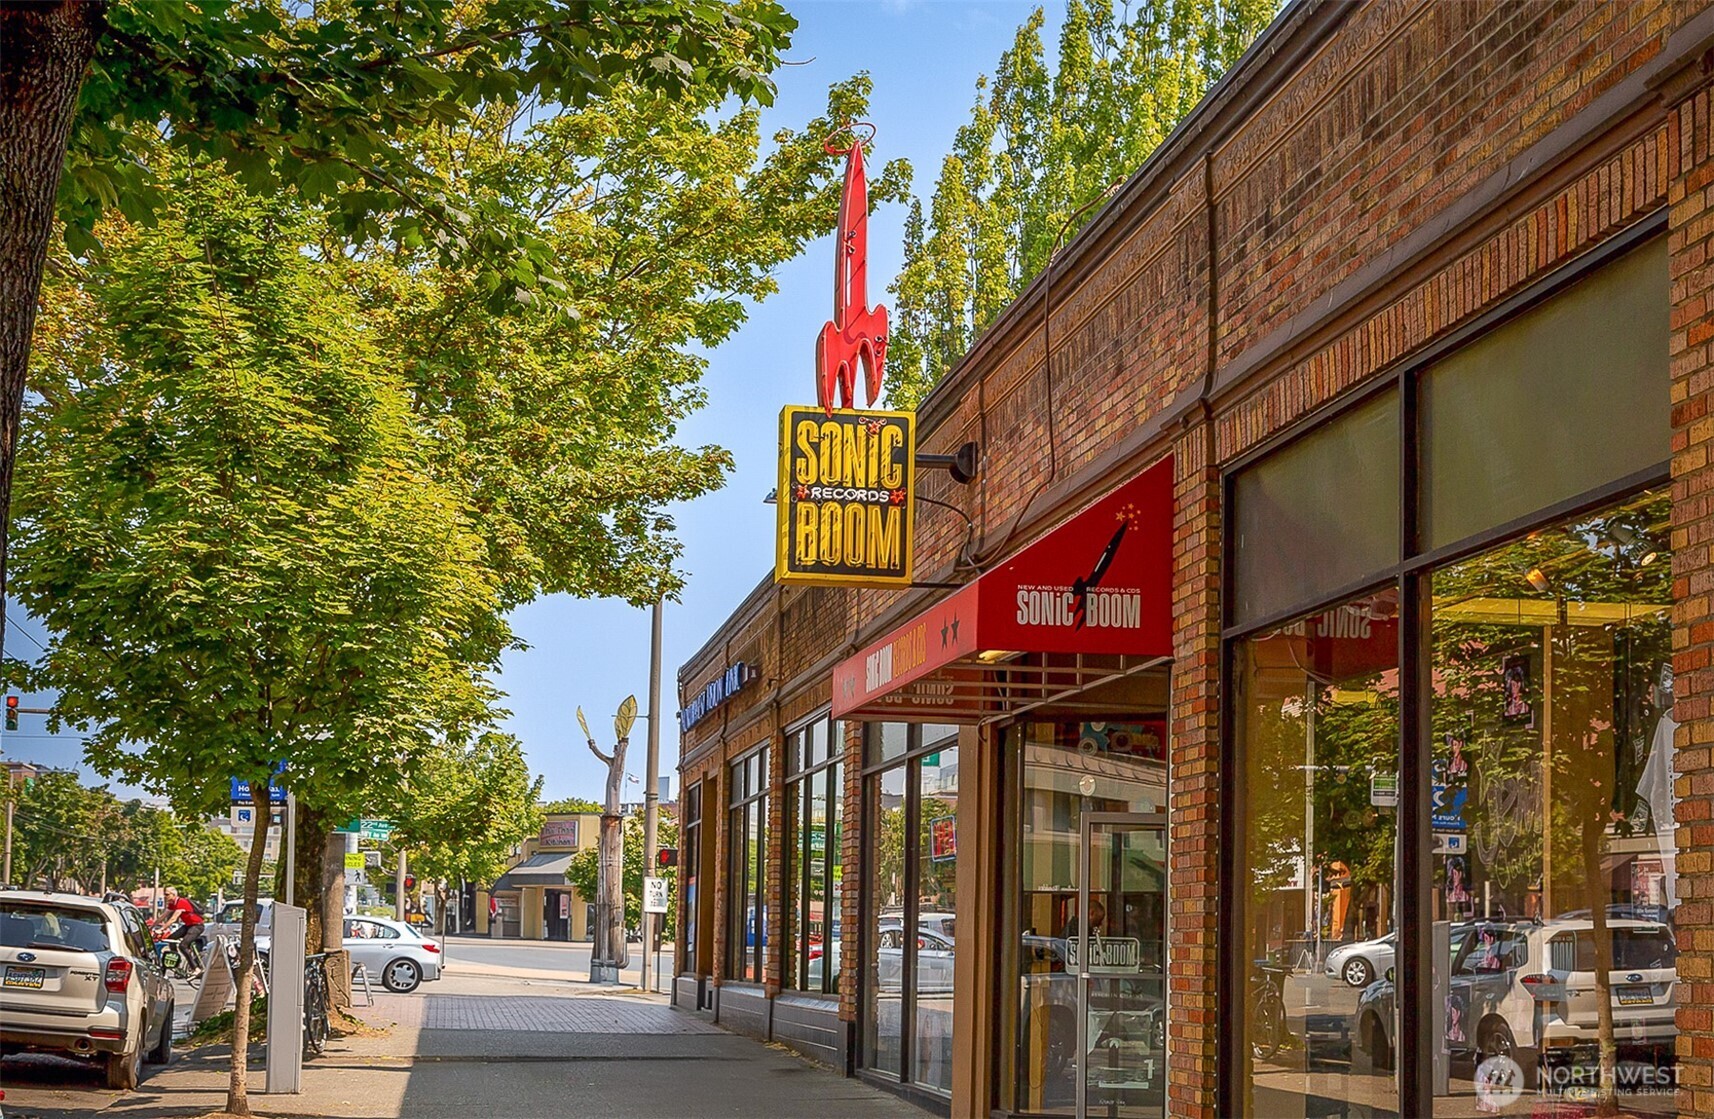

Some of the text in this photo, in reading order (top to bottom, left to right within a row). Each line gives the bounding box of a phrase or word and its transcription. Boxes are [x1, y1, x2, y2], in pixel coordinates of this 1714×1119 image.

[810, 486, 890, 503] RECORDS
[796, 501, 901, 570] BOOM
[1086, 593, 1141, 628] BOOM
[651, 881, 663, 890] NO
[1105, 943, 1136, 966] BOOM
